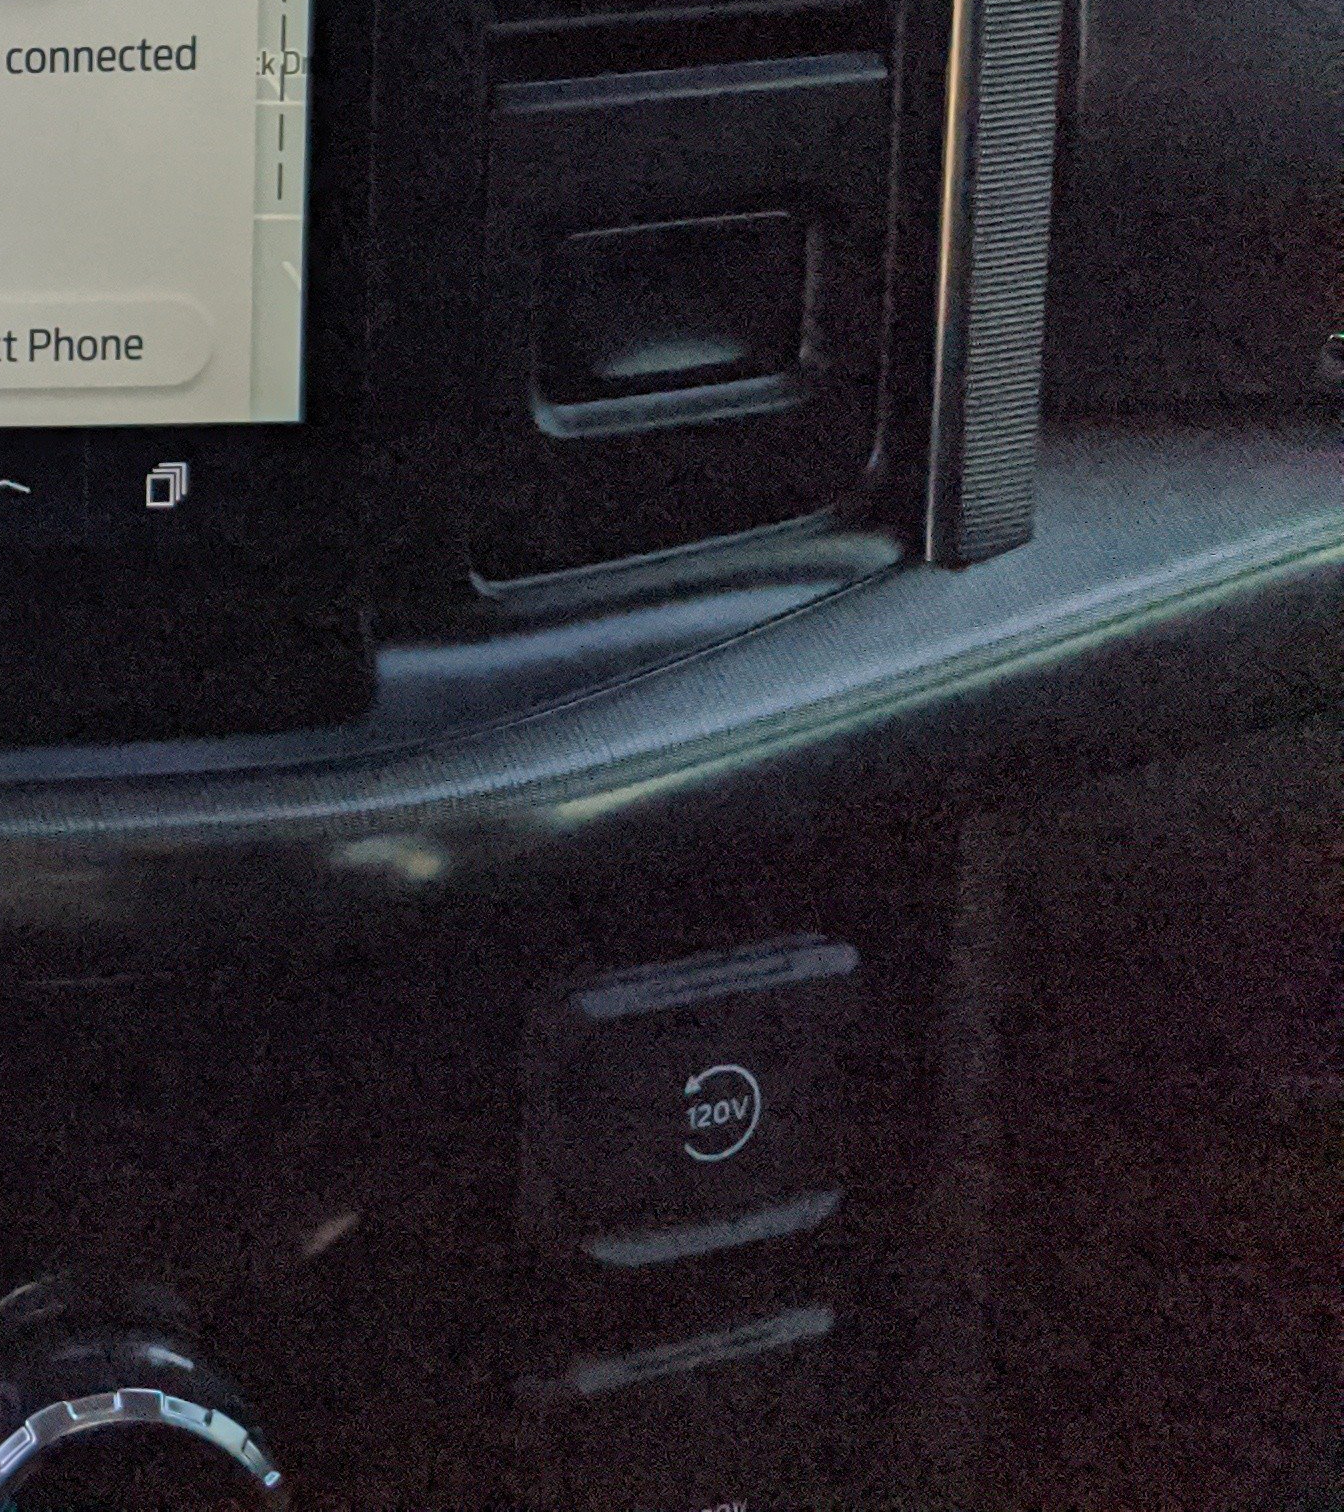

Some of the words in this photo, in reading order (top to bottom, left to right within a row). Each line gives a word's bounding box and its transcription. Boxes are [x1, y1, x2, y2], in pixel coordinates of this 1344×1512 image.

[6, 36, 198, 74] connected
[28, 328, 144, 363] Phone
[687, 1096, 752, 1129] 120V
